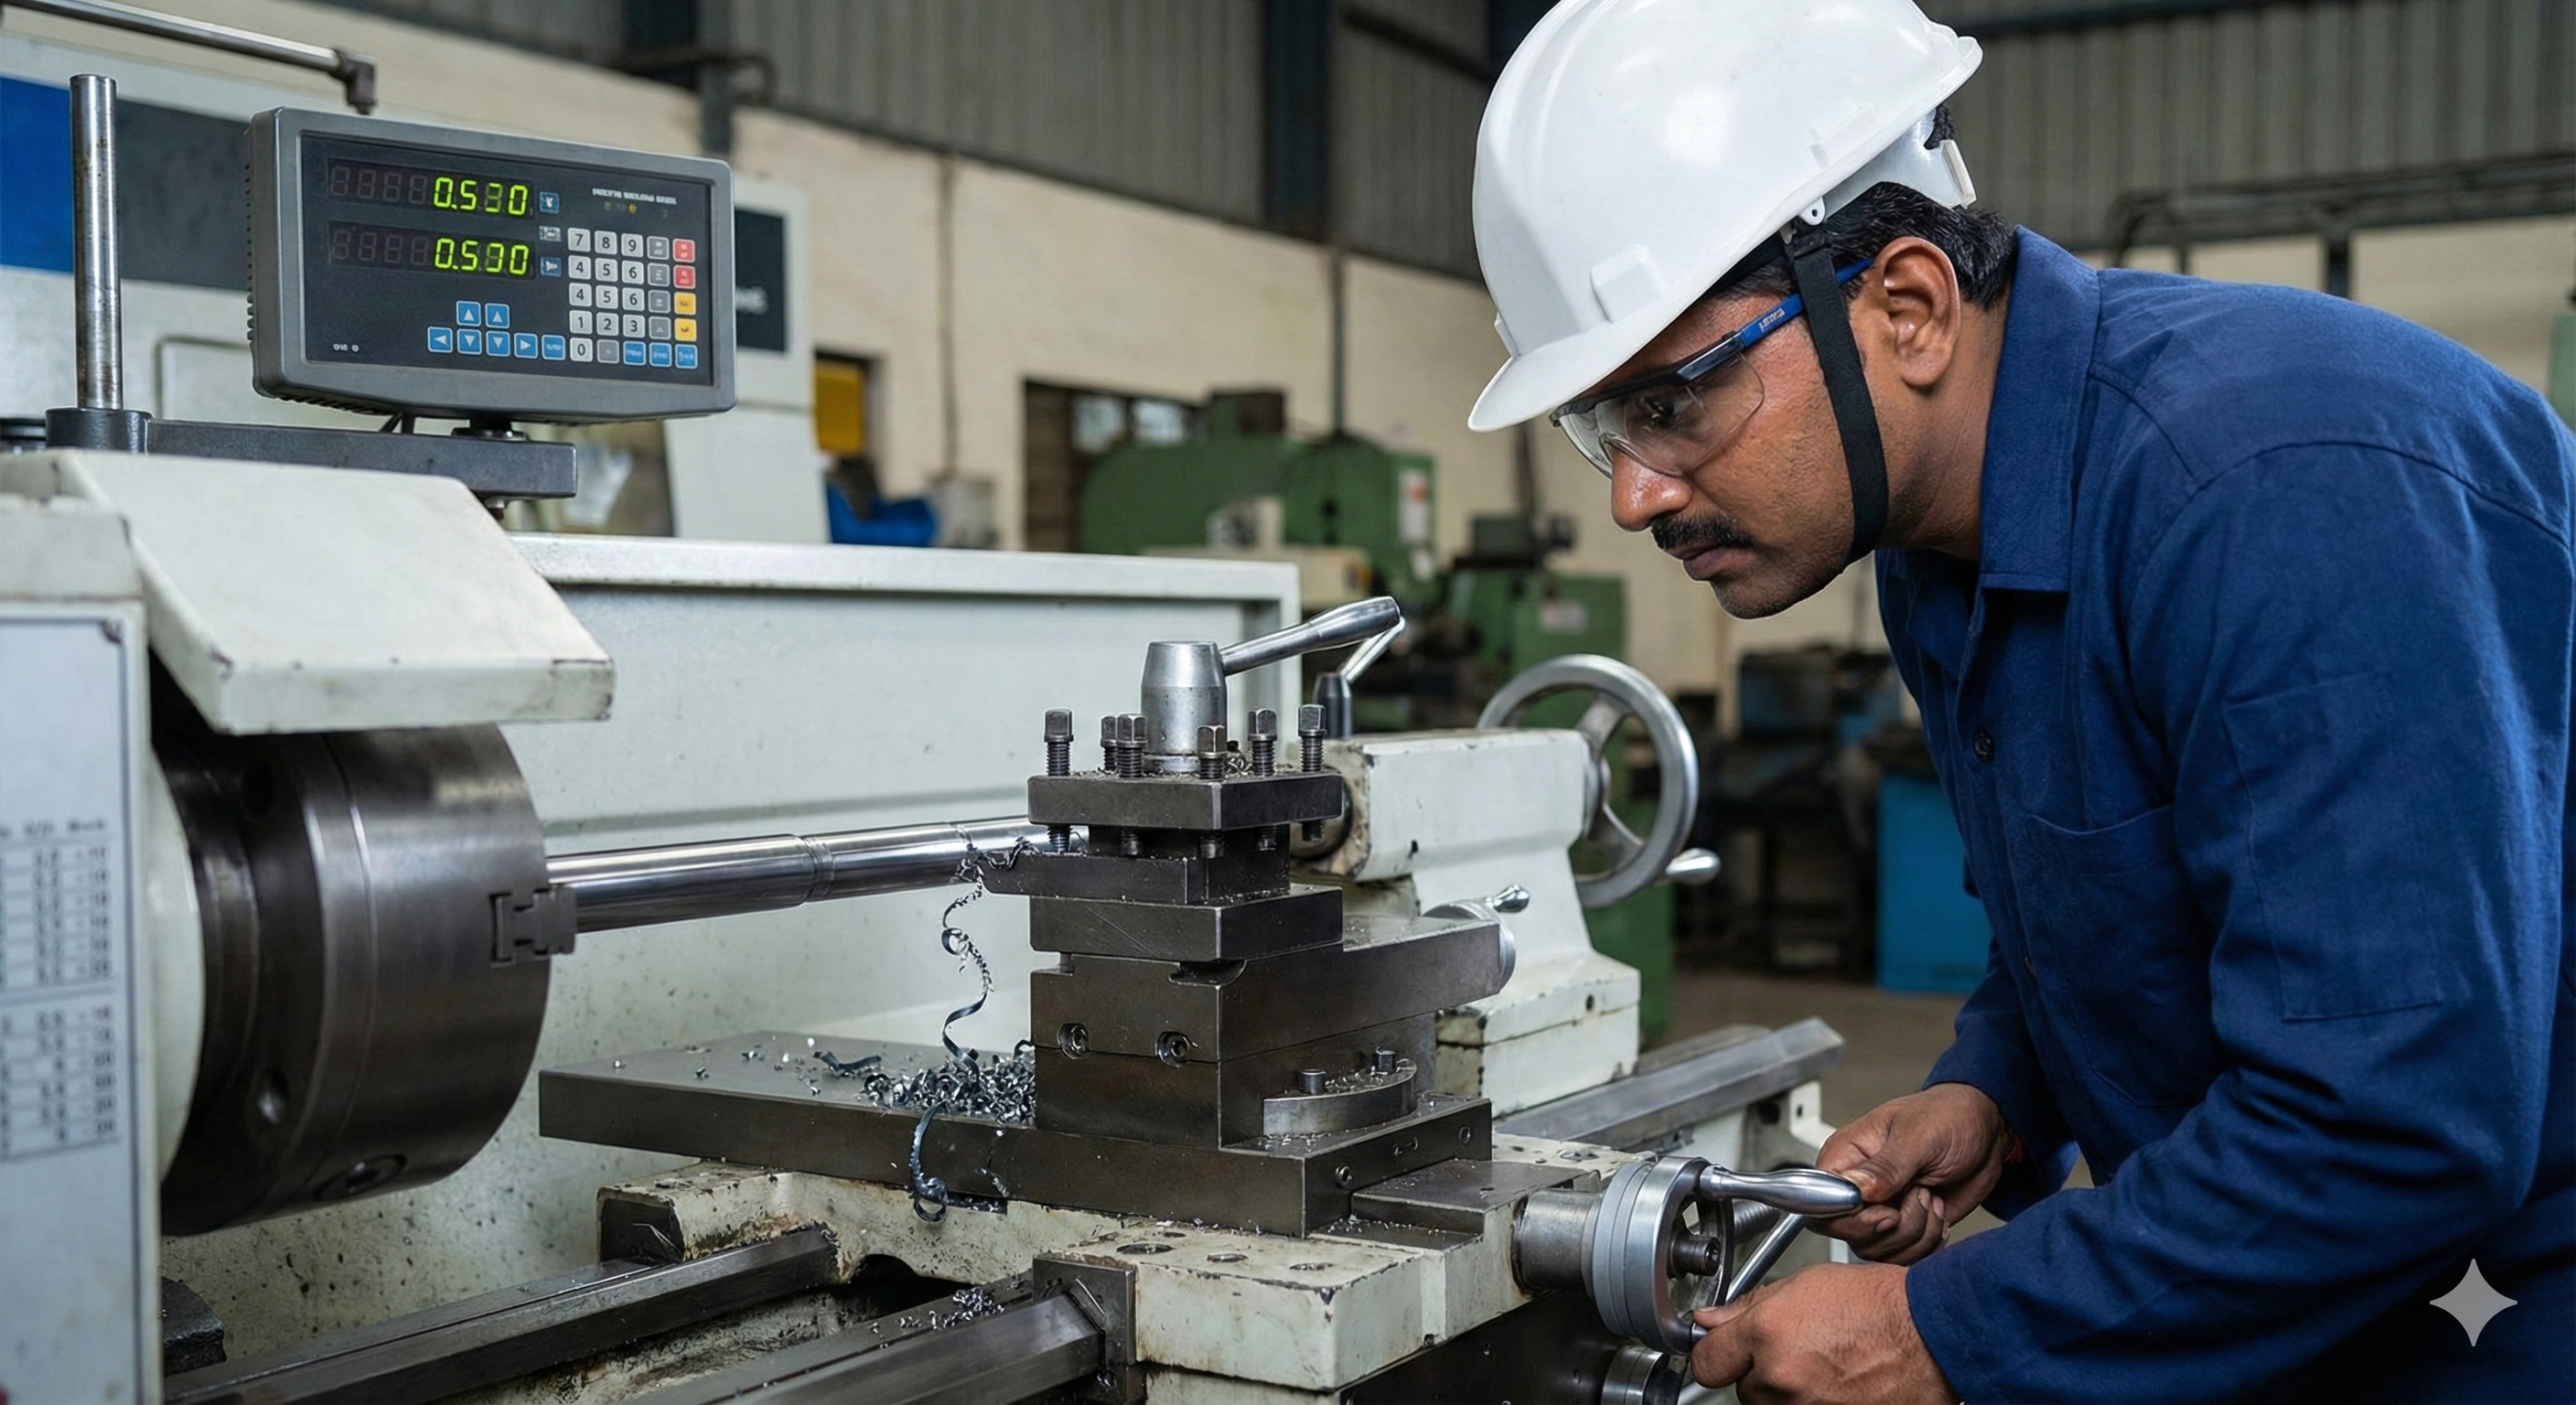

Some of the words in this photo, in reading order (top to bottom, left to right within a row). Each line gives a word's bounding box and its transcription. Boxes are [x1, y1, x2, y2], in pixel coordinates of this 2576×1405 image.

[574, 233, 584, 247] 7
[602, 236, 610, 250] 8
[628, 239, 637, 252] 9
[575, 261, 585, 273] 4
[603, 263, 611, 276] 5
[628, 266, 638, 279] 6
[575, 288, 585, 301] 4
[603, 290, 611, 304] 5
[629, 293, 638, 306] 6
[577, 316, 584, 328] 1
[603, 317, 612, 331] 2
[630, 319, 638, 333] 3
[577, 343, 586, 357] 0
